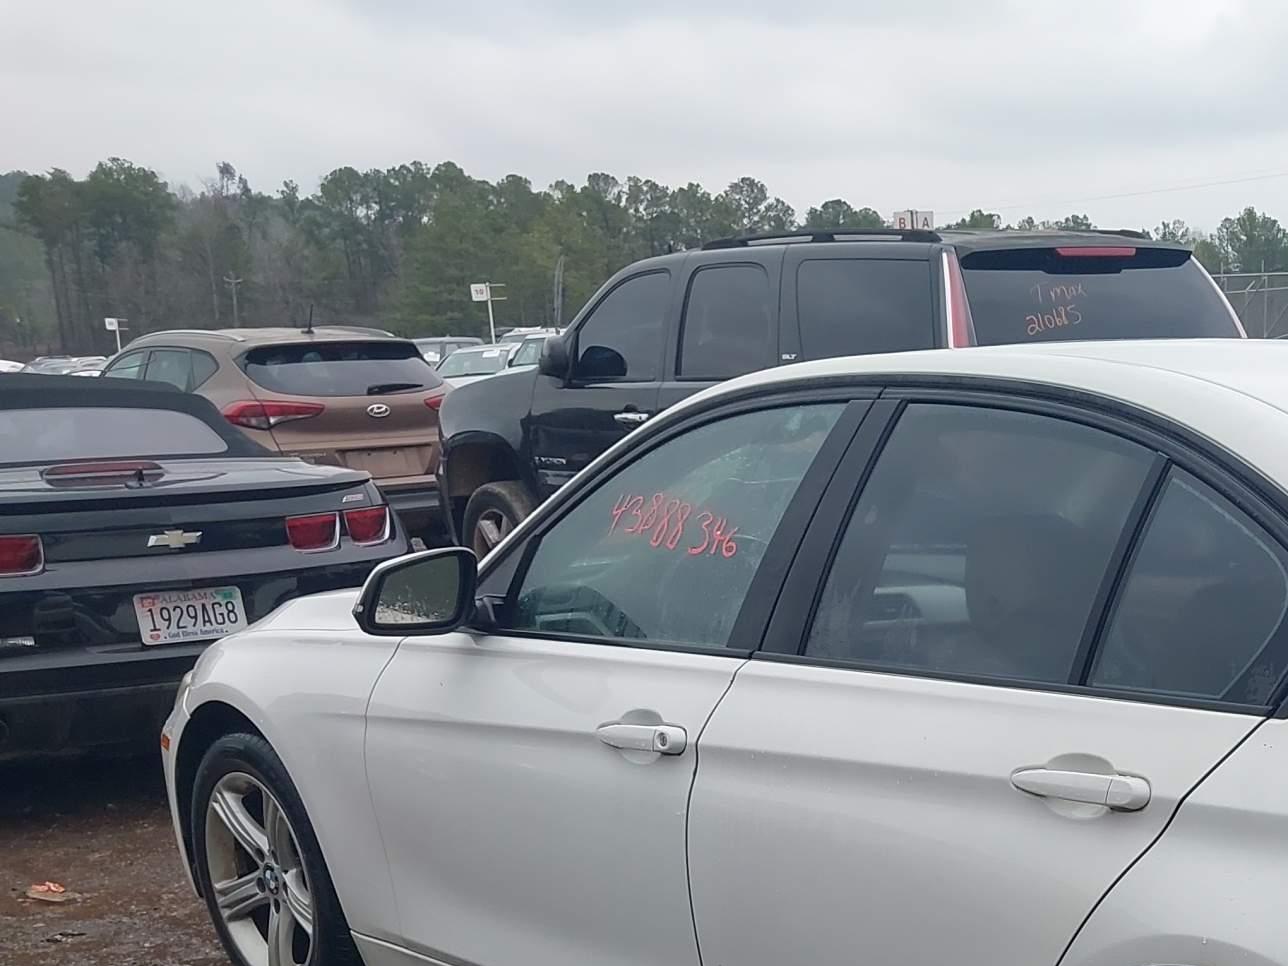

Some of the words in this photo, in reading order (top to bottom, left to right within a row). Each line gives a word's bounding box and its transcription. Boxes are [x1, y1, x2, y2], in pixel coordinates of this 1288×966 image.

[898, 217, 906, 229] B
[922, 216, 930, 229] A
[146, 600, 239, 633] 1929AG8
